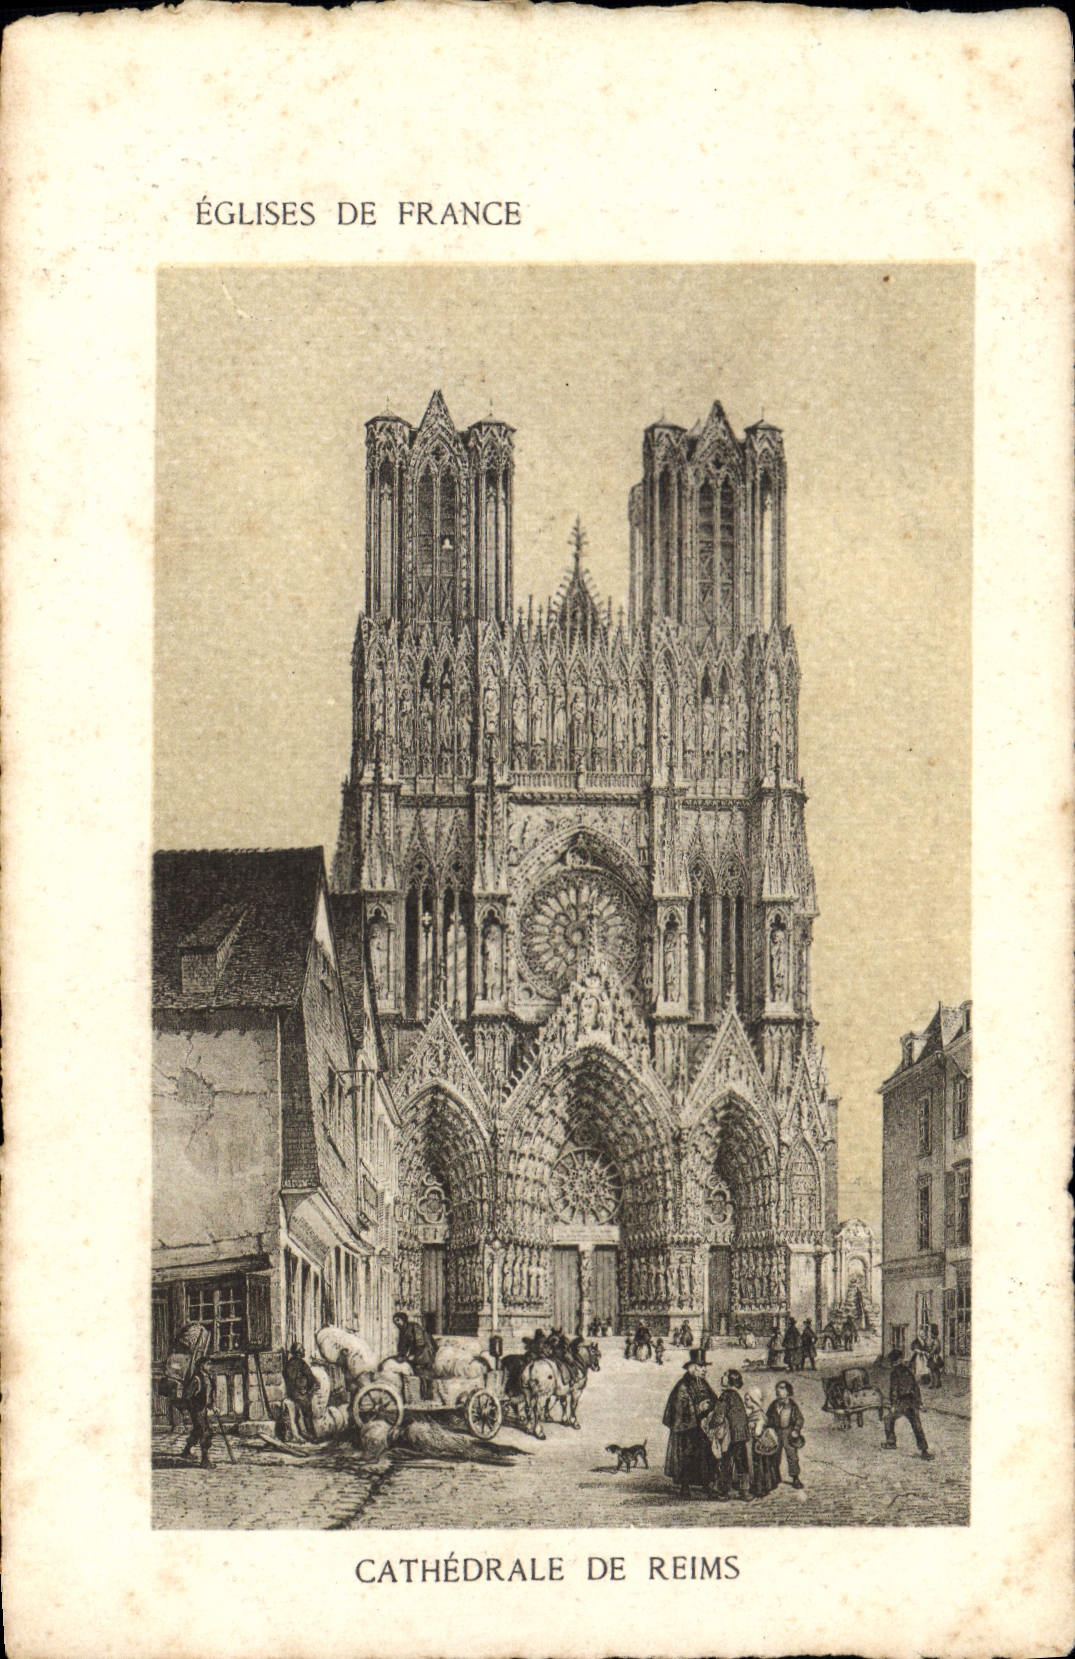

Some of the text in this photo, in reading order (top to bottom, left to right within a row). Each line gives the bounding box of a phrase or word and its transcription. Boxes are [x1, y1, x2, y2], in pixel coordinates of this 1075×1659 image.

[196, 195, 521, 226] ÉGLISES DE FRANCE
[355, 1551, 740, 1584] CATHÉDRALE DE REIMS
